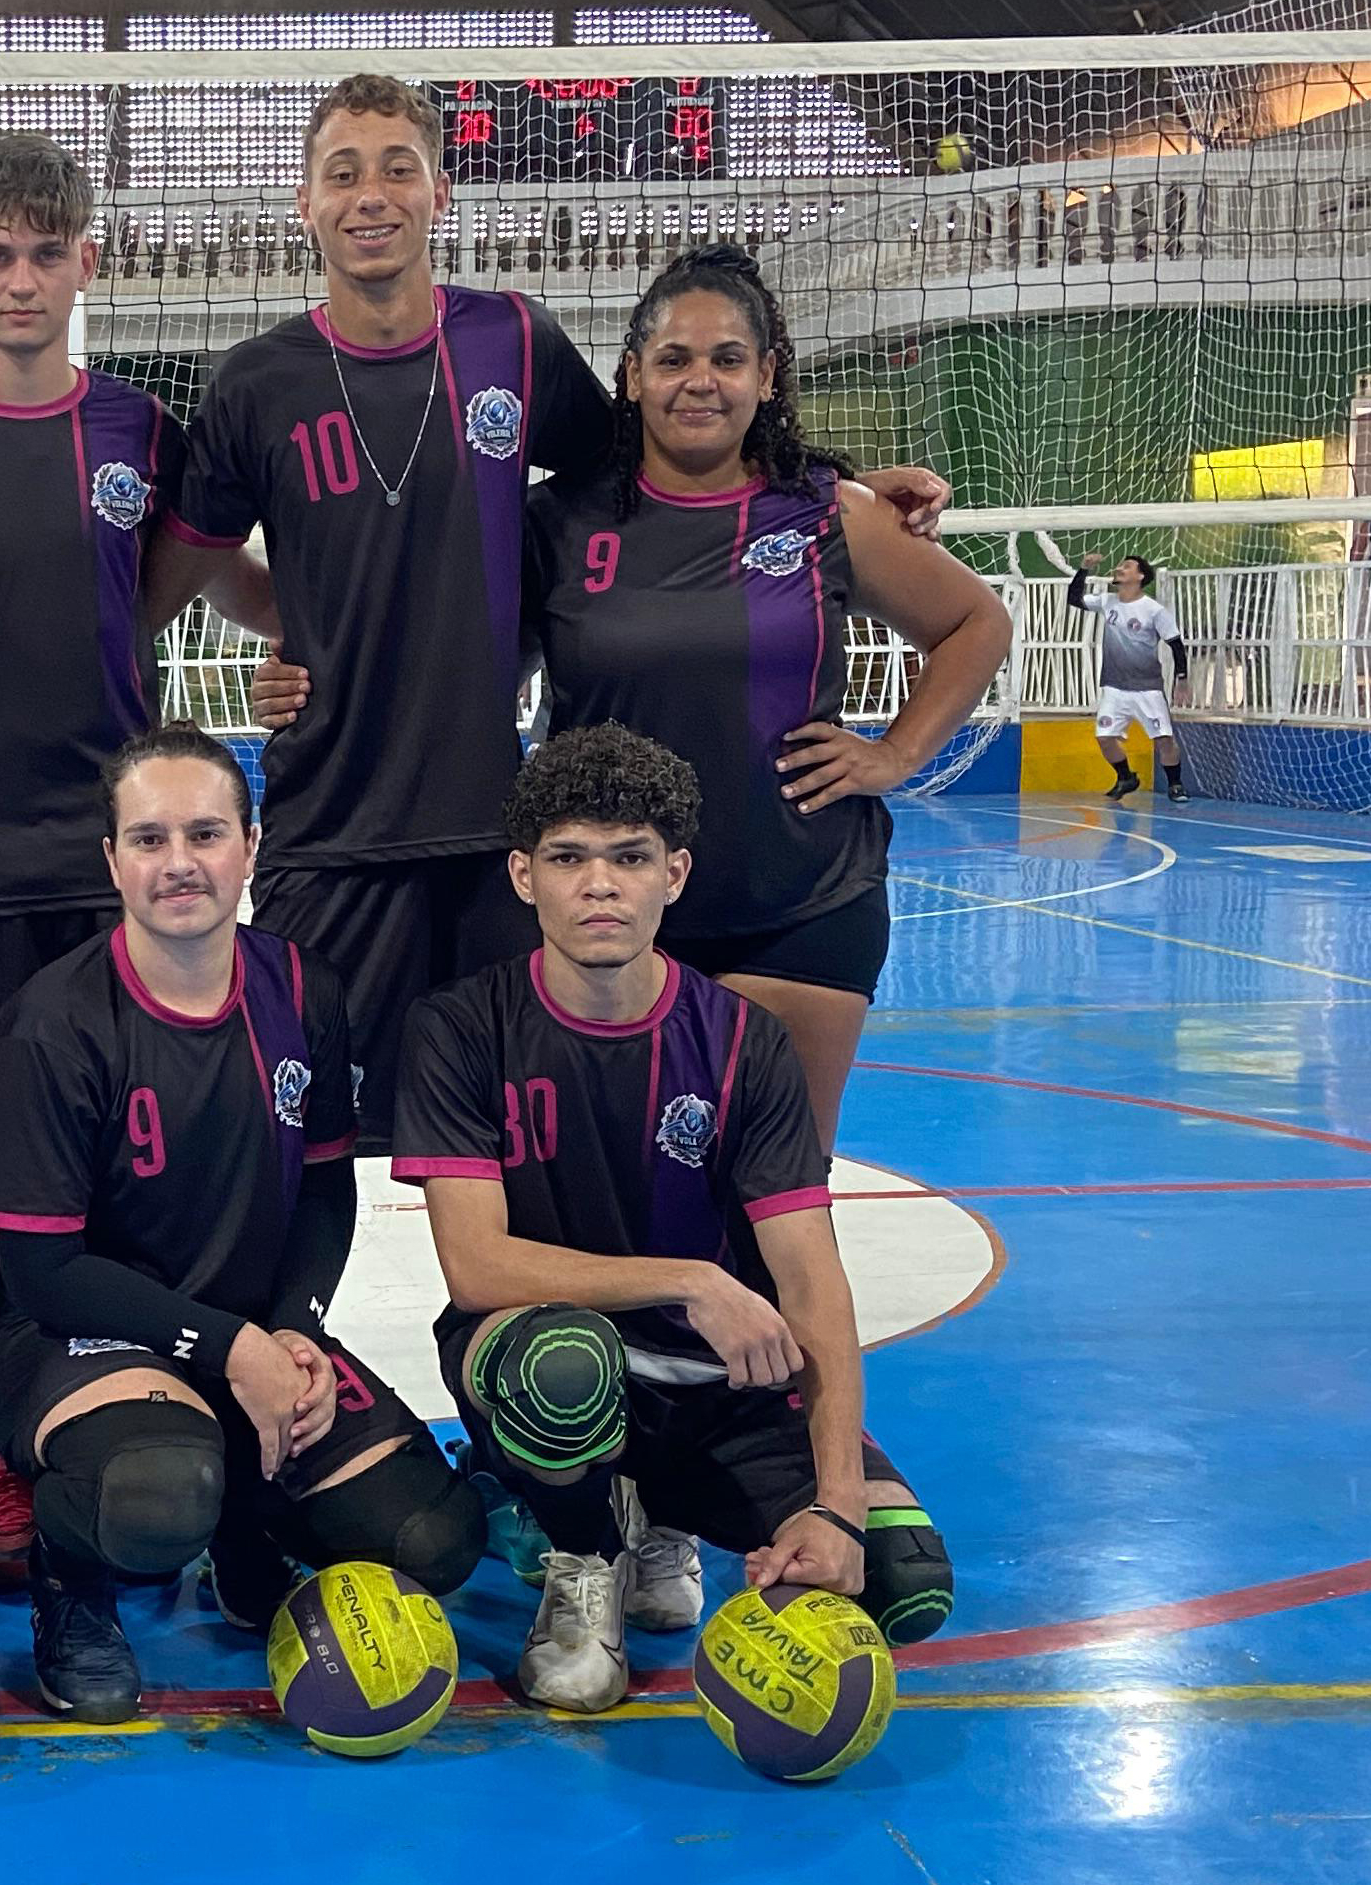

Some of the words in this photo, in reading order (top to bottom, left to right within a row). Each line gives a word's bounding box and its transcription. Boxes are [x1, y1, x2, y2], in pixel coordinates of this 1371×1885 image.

[290, 411, 359, 502] 10
[584, 532, 621, 593] 9
[128, 1086, 166, 1178] 9
[316, 1644, 340, 1675] 8.0
[336, 1573, 386, 1672] PENALTY
